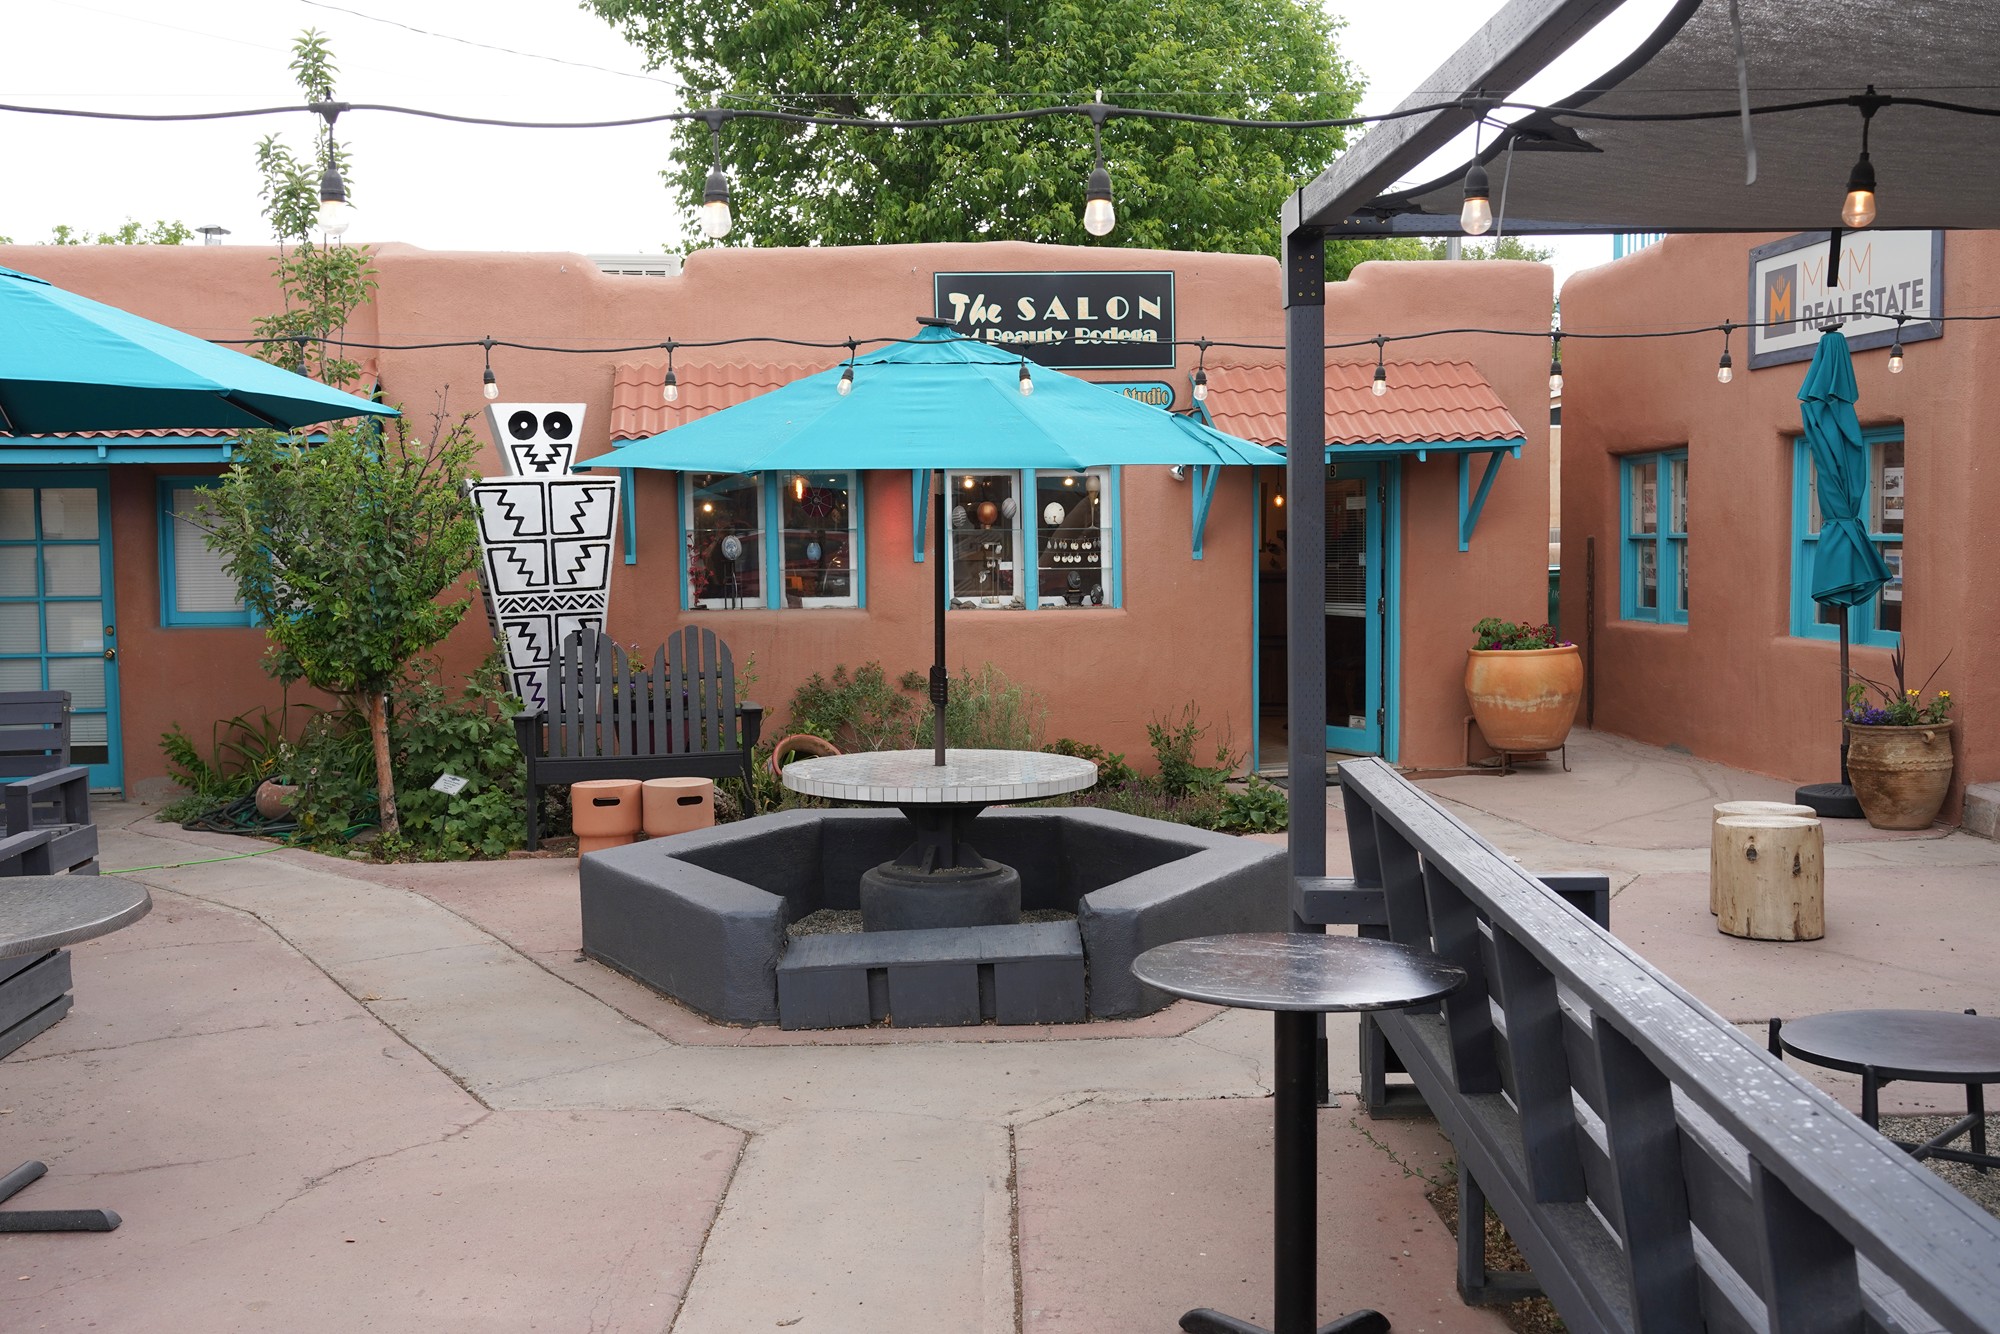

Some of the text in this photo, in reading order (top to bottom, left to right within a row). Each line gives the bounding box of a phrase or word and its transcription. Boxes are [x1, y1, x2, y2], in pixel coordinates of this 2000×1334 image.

[948, 292, 1161, 326] The SALON
[1802, 278, 1924, 332] REAL ESTATE
[986, 326, 1068, 346] Beauty
[1074, 326, 1158, 345] Bodega
